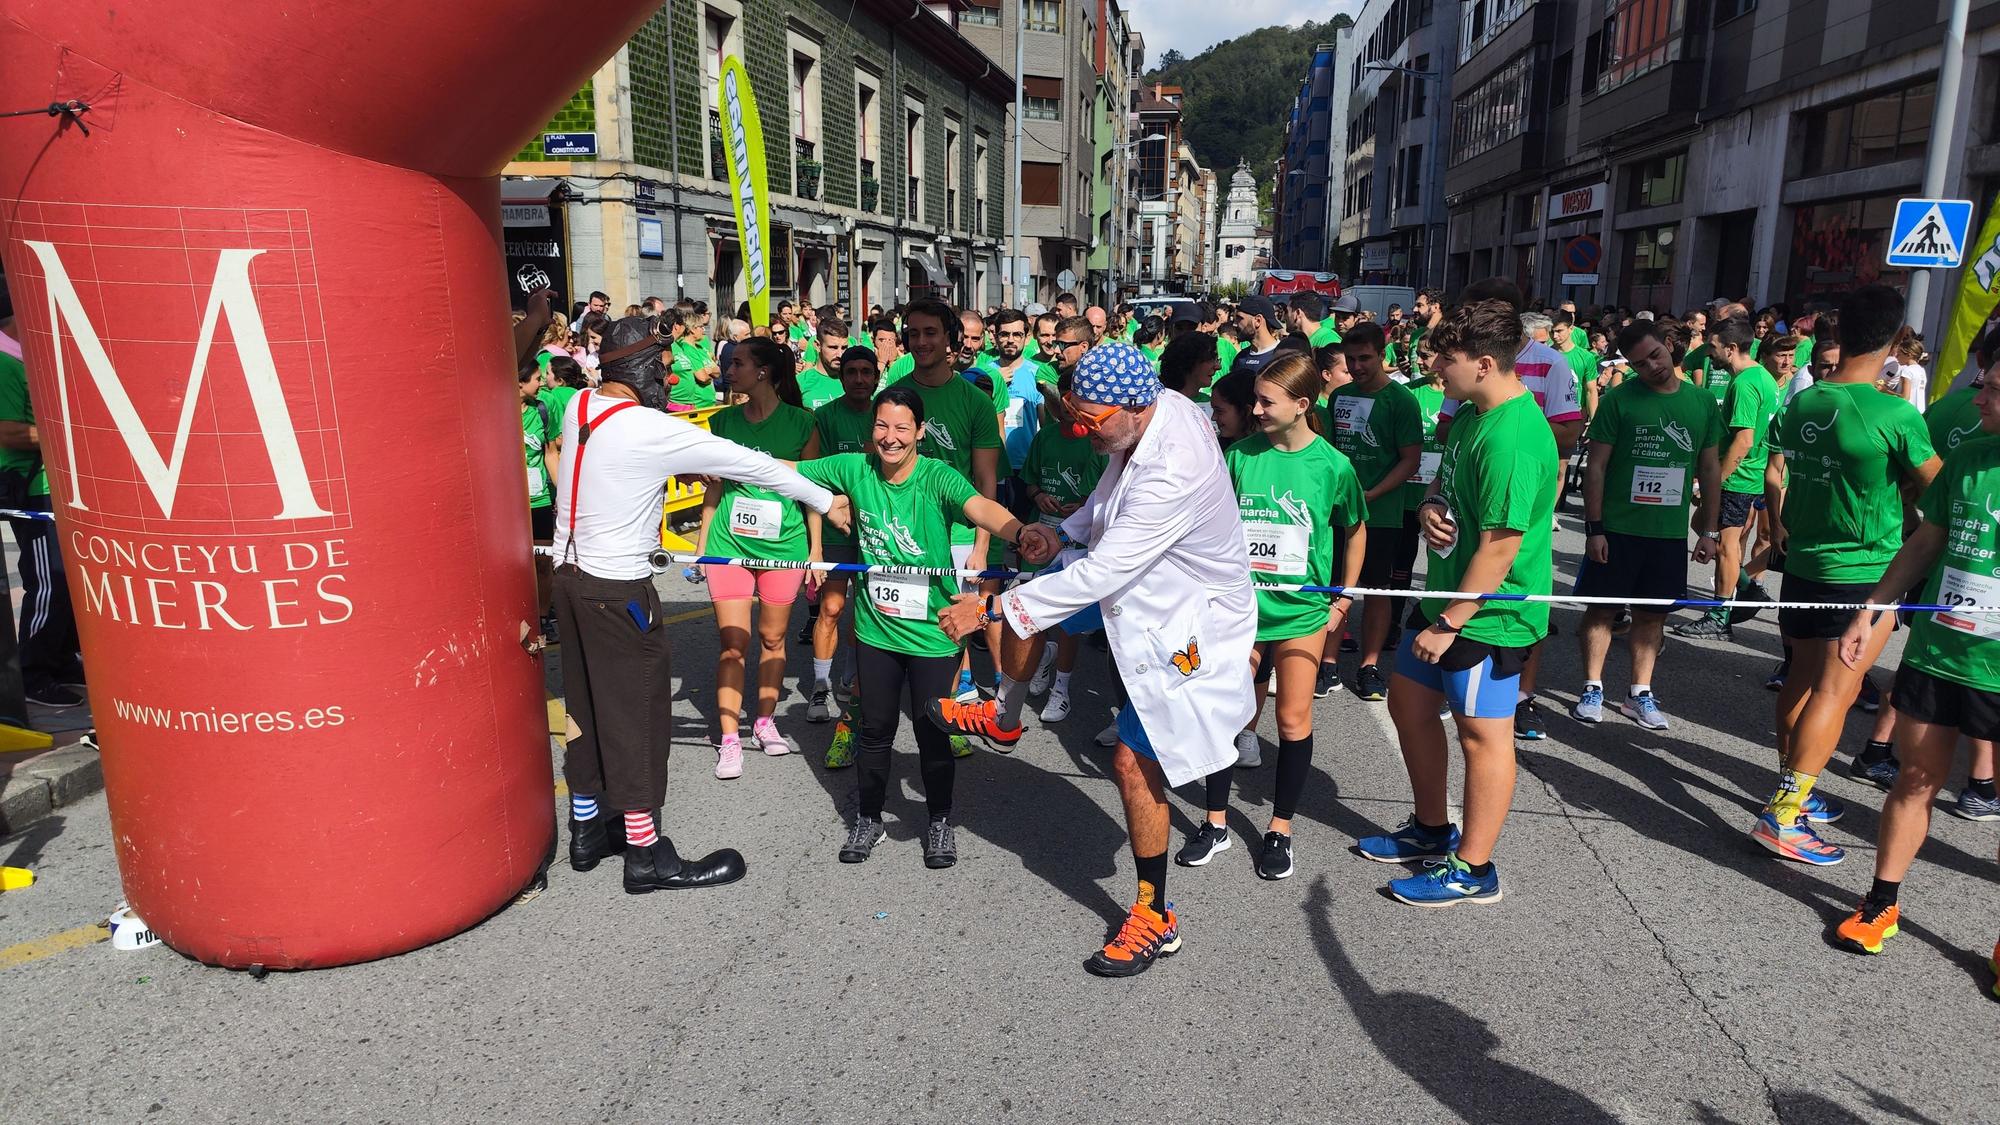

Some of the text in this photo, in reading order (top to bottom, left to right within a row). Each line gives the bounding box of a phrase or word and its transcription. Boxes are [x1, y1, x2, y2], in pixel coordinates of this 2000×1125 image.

[641, 185, 655, 197] CALLE
[24, 240, 334, 521] M
[1335, 408, 1352, 419] 205
[1635, 434, 1665, 442] marcha
[1641, 449, 1671, 458] cáncer
[1638, 481, 1662, 493] 112
[1240, 496, 1253, 506] En
[1240, 507, 1279, 518] marcha
[1952, 502, 1963, 514] En
[736, 512, 757, 525] 150
[859, 512, 870, 523] En
[72, 530, 350, 574] CONCEYU DE
[1249, 542, 1277, 558] 204
[79, 564, 354, 632] MIERES
[874, 586, 900, 602] 136
[113, 697, 346, 734] www.mieres.es
